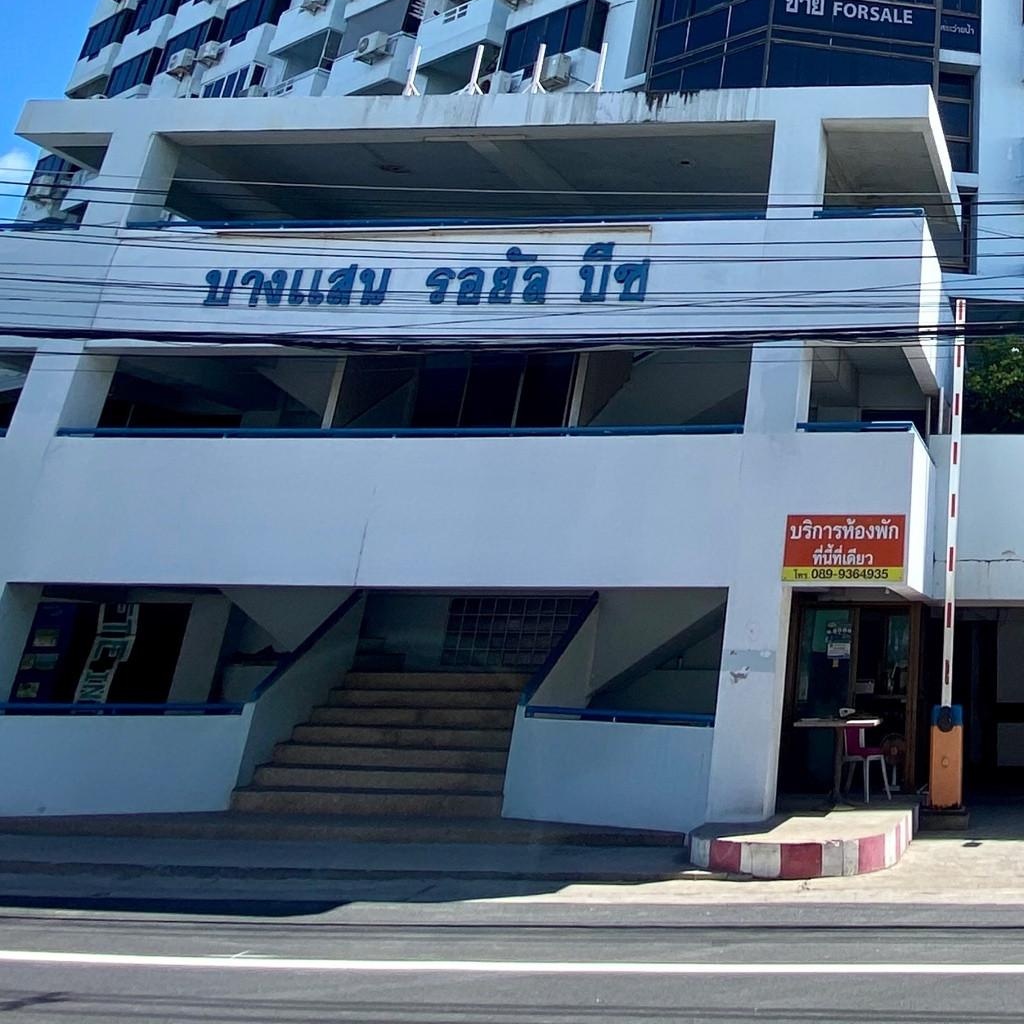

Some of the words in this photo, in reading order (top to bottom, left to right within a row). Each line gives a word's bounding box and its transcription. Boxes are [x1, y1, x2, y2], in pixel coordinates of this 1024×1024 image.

[202, 263, 393, 308] บางแสน
[426, 246, 550, 305] รอยัล
[578, 242, 650, 303] บีช
[790, 518, 899, 540] บริการห้องพัก
[811, 568, 888, 579] 089-9364935
